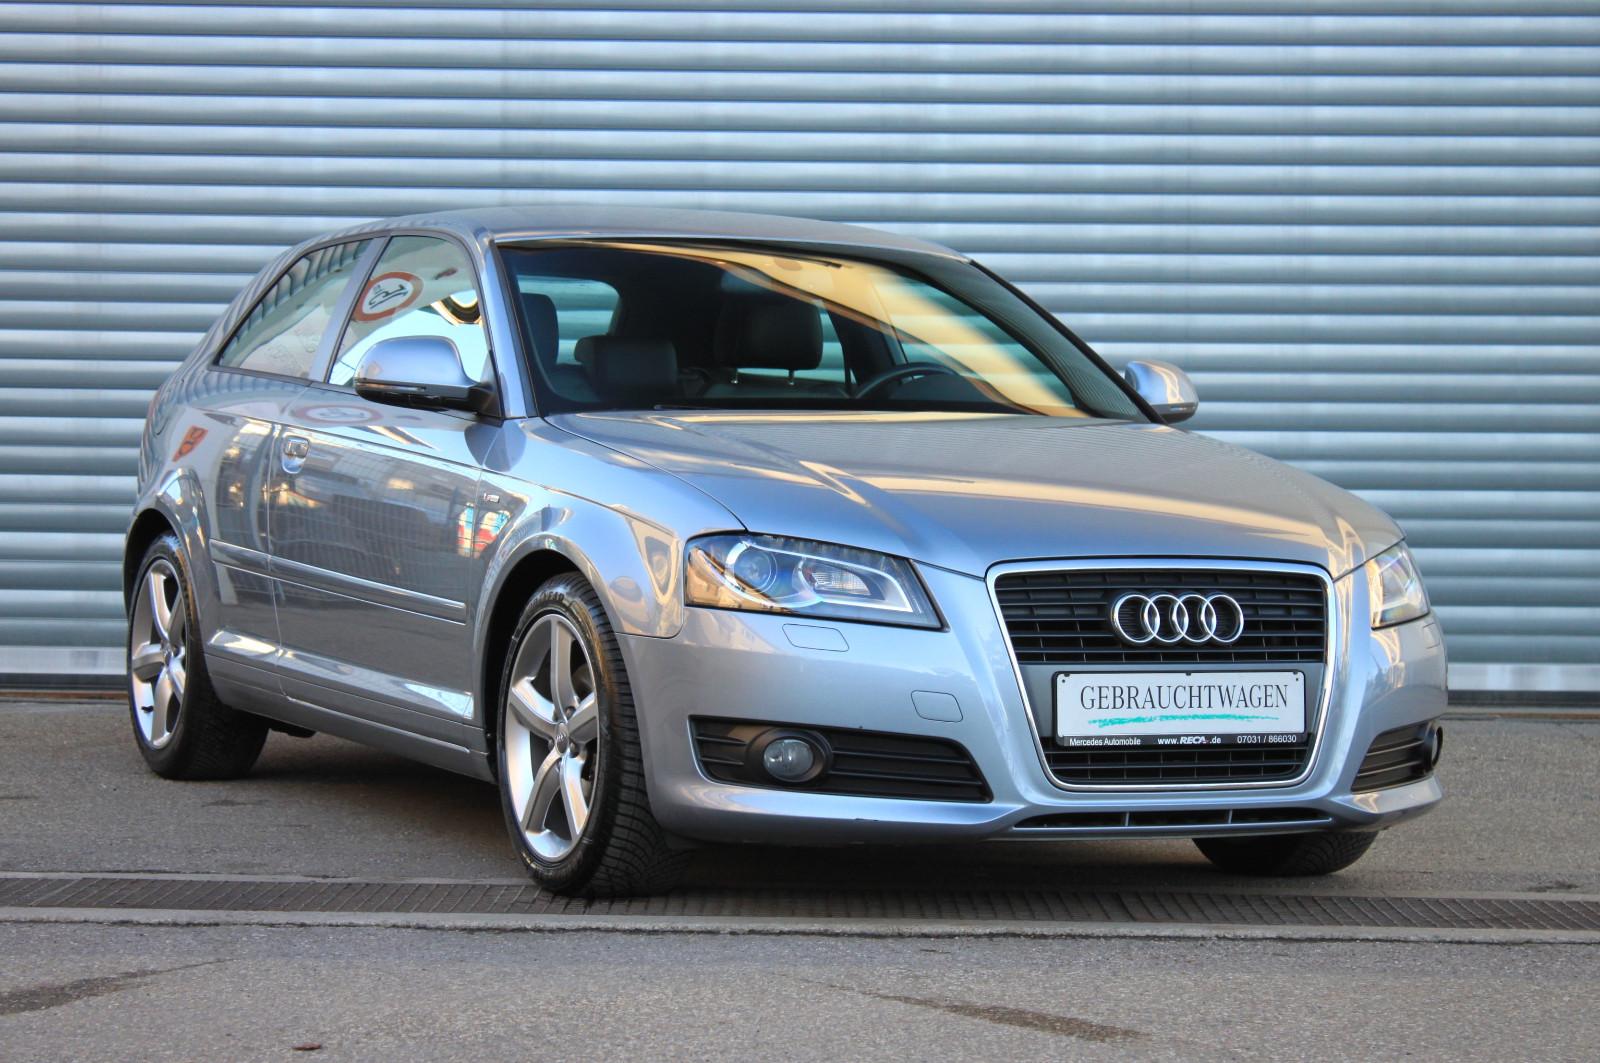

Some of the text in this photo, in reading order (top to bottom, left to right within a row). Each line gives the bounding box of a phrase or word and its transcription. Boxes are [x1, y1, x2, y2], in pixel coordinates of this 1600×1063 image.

[1080, 684, 1288, 709] GEBRAUCHTWAGEN
[1069, 737, 1103, 746] Mercedes
[1104, 737, 1141, 746] Automobile
[1237, 735, 1262, 744] 07031
[1268, 734, 1297, 744] 866030
